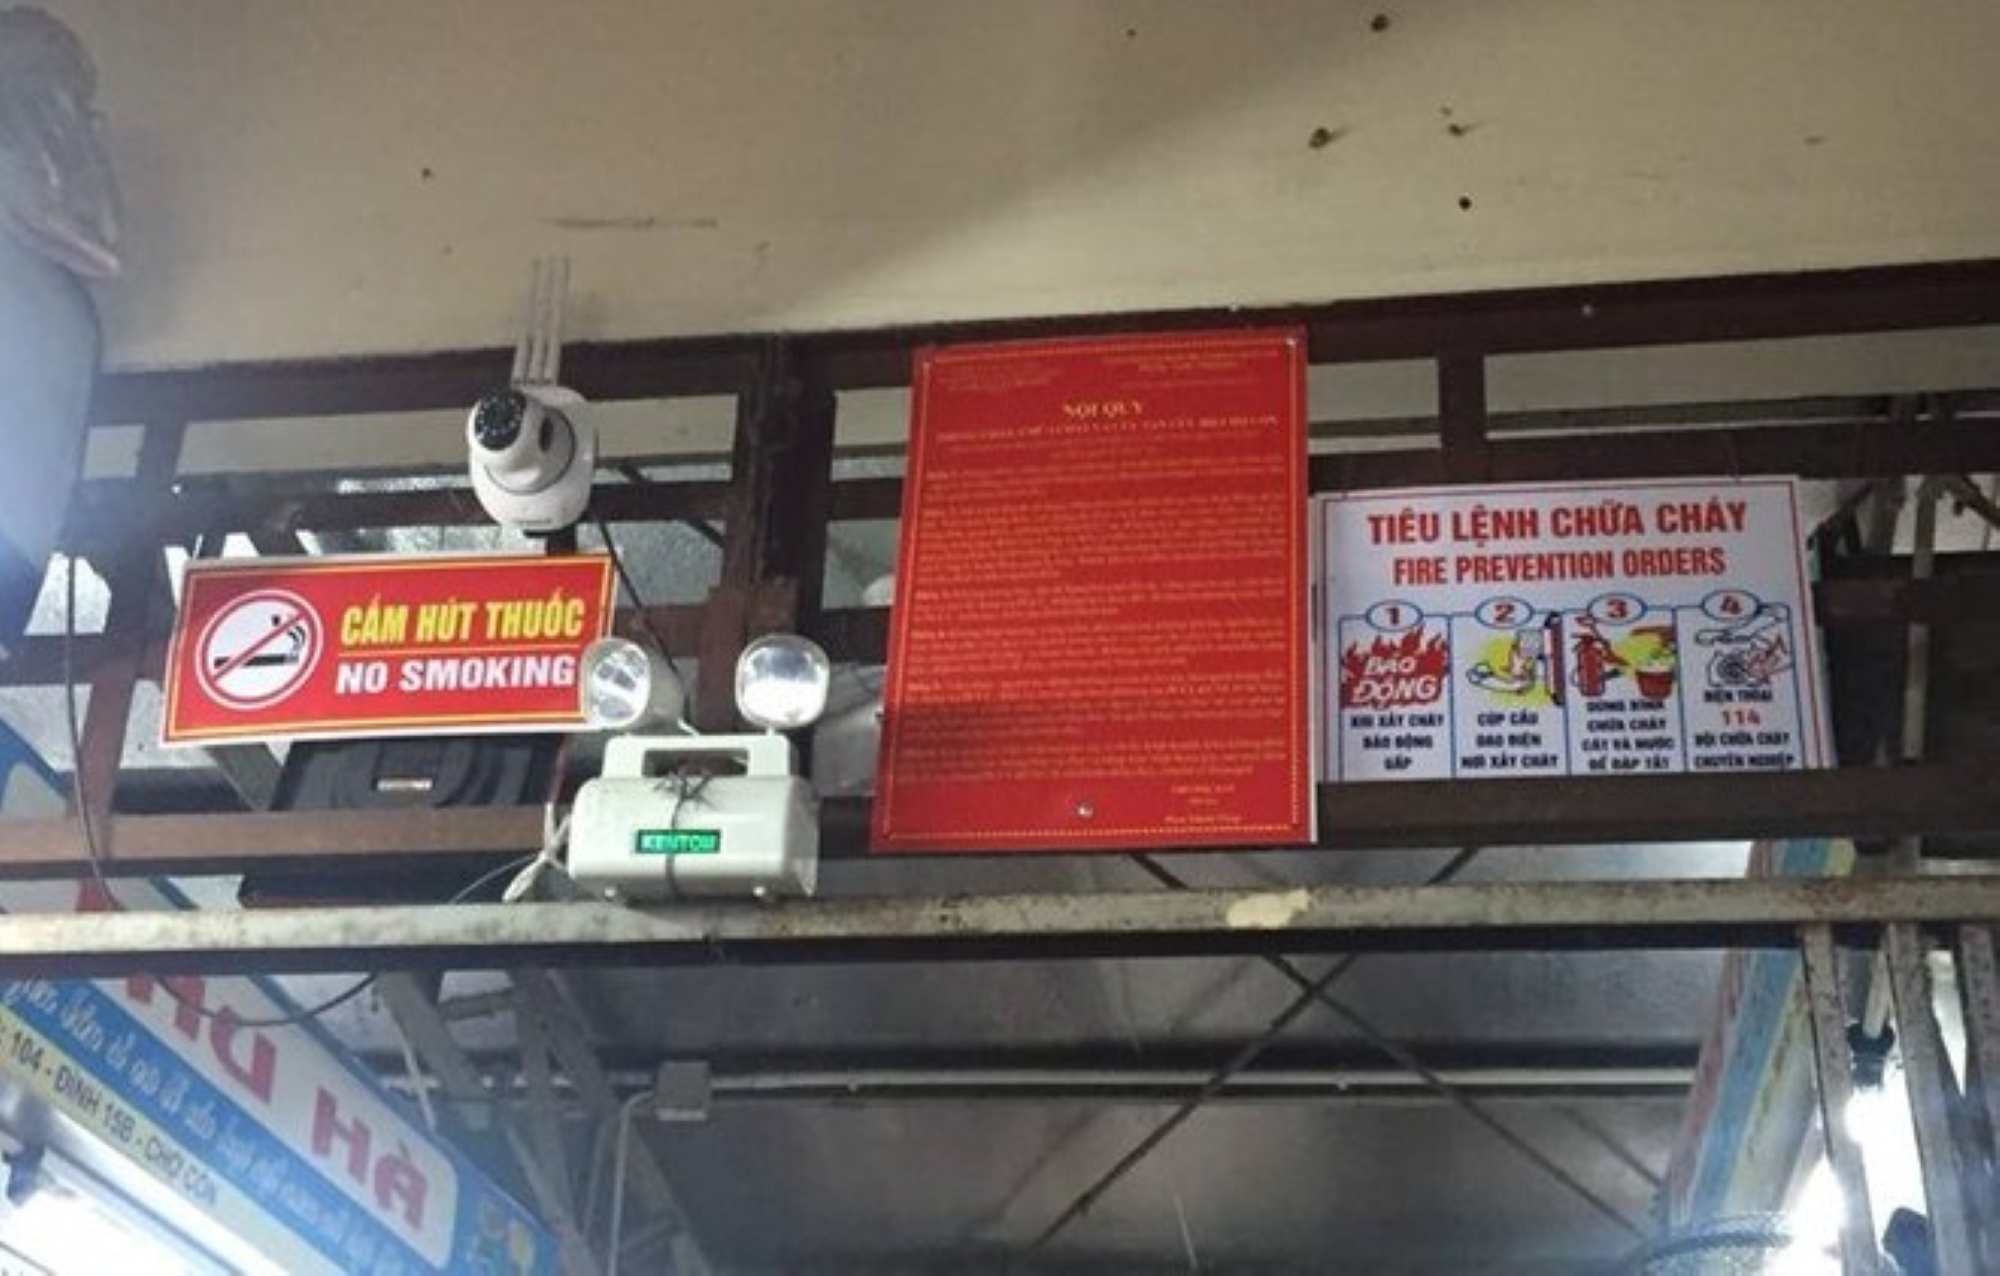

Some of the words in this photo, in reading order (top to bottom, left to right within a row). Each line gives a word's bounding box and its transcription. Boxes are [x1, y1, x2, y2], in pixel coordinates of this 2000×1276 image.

[1367, 507, 1440, 544] TIÊU
[1452, 504, 1539, 547] LỆNH
[1550, 499, 1645, 537] CHỮA
[1656, 496, 1746, 533] CHÁY
[1393, 556, 1448, 585] FIRE
[1456, 551, 1614, 583] PREVENTION
[1622, 547, 1726, 577] ORDERS
[341, 592, 409, 646] CẤM
[415, 597, 478, 642] HÚT
[485, 587, 585, 639] THUỐC
[1386, 607, 1400, 625] 1
[1494, 604, 1515, 622] 2
[1607, 601, 1628, 619] 3
[1719, 597, 1742, 615] 4
[336, 661, 388, 694] NO
[398, 654, 576, 691] SMOKING
[1352, 675, 1438, 706] ĐỘNG
[1721, 709, 1762, 726] 114
[10, 1032, 44, 1073] 104
[310, 1085, 429, 1231] HÀ
